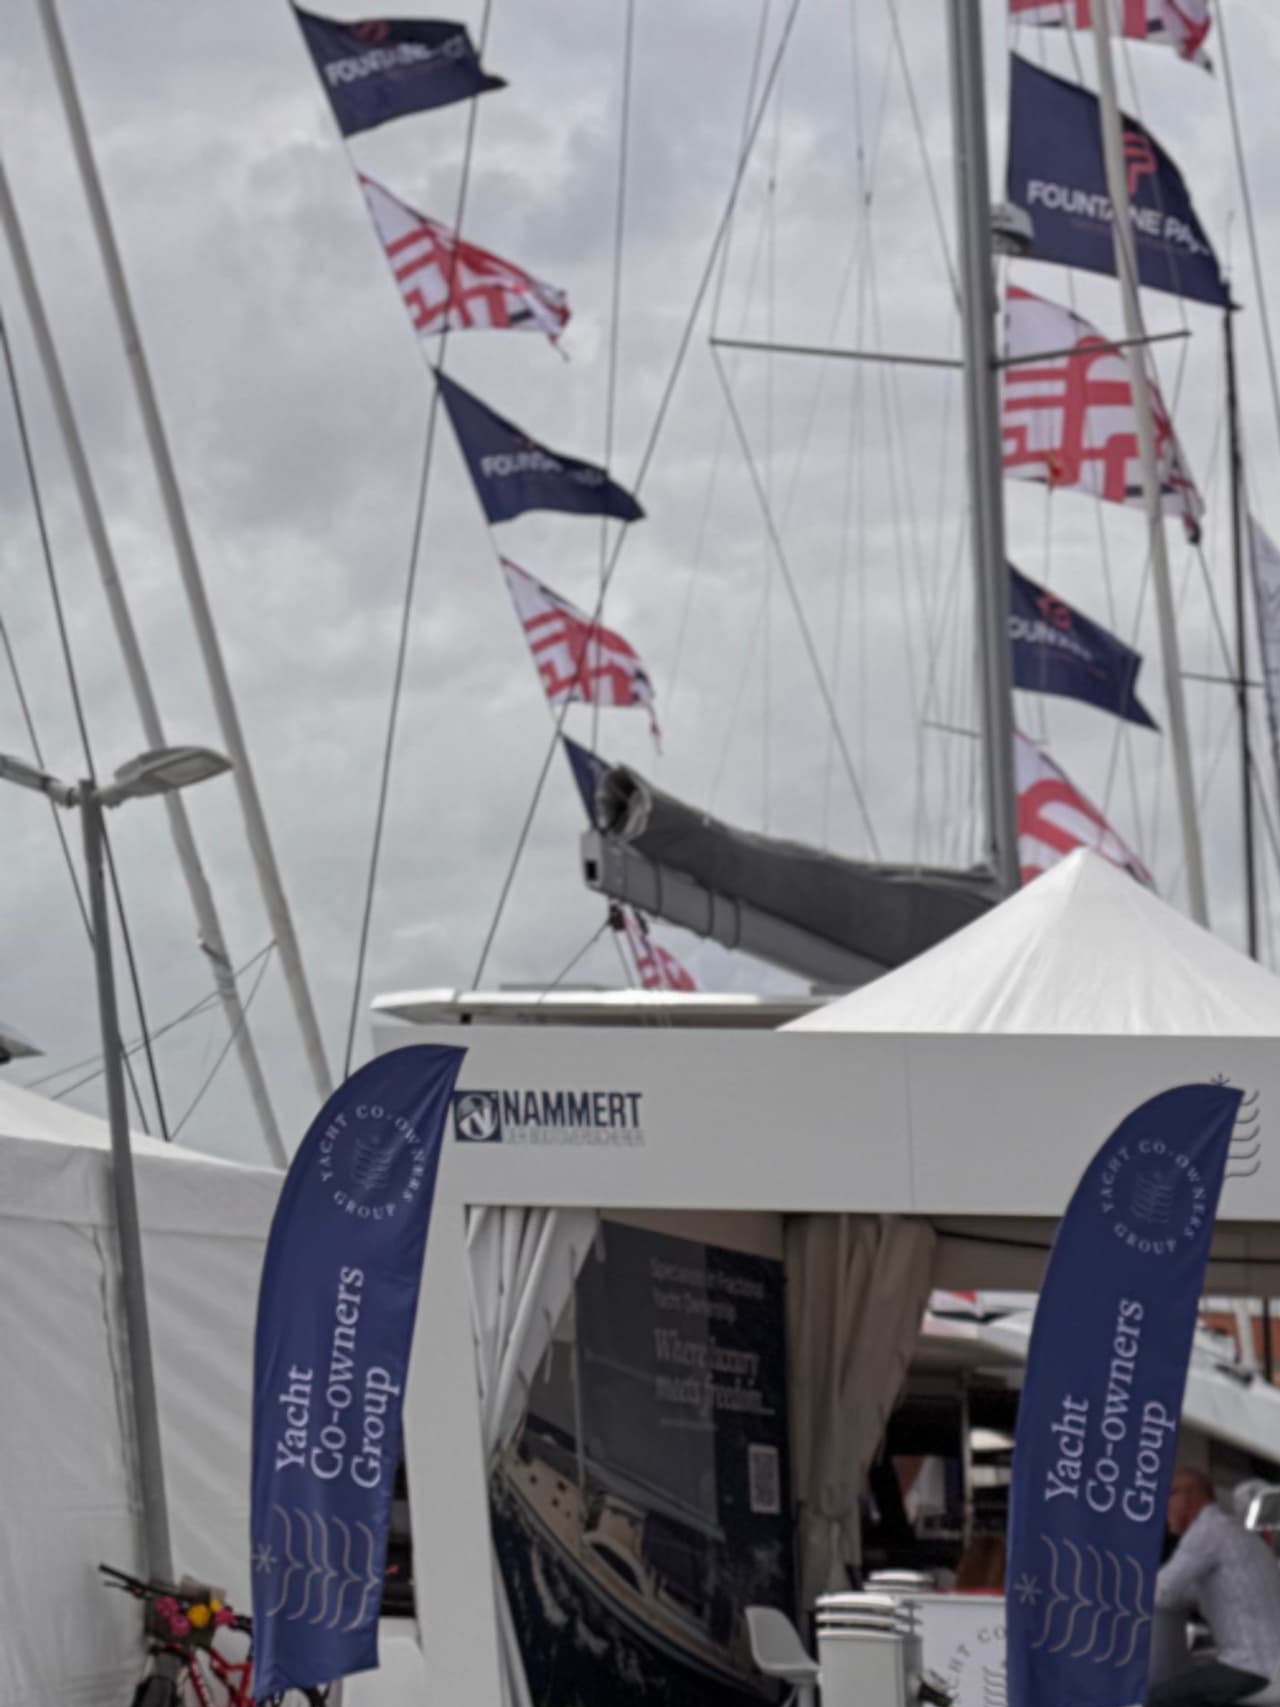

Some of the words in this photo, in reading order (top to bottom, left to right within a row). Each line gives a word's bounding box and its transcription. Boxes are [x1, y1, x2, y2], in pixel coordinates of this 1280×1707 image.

[1026, 179, 1161, 236] FOUNTANE
[502, 1090, 643, 1128] NAMMERT
[275, 1363, 313, 1473] Yacht
[310, 1265, 364, 1480] Co-owners
[351, 1365, 400, 1489] Group
[1086, 1298, 1144, 1513] Co-owners
[1045, 1395, 1089, 1502] Yacht
[1122, 1401, 1176, 1523] Group
